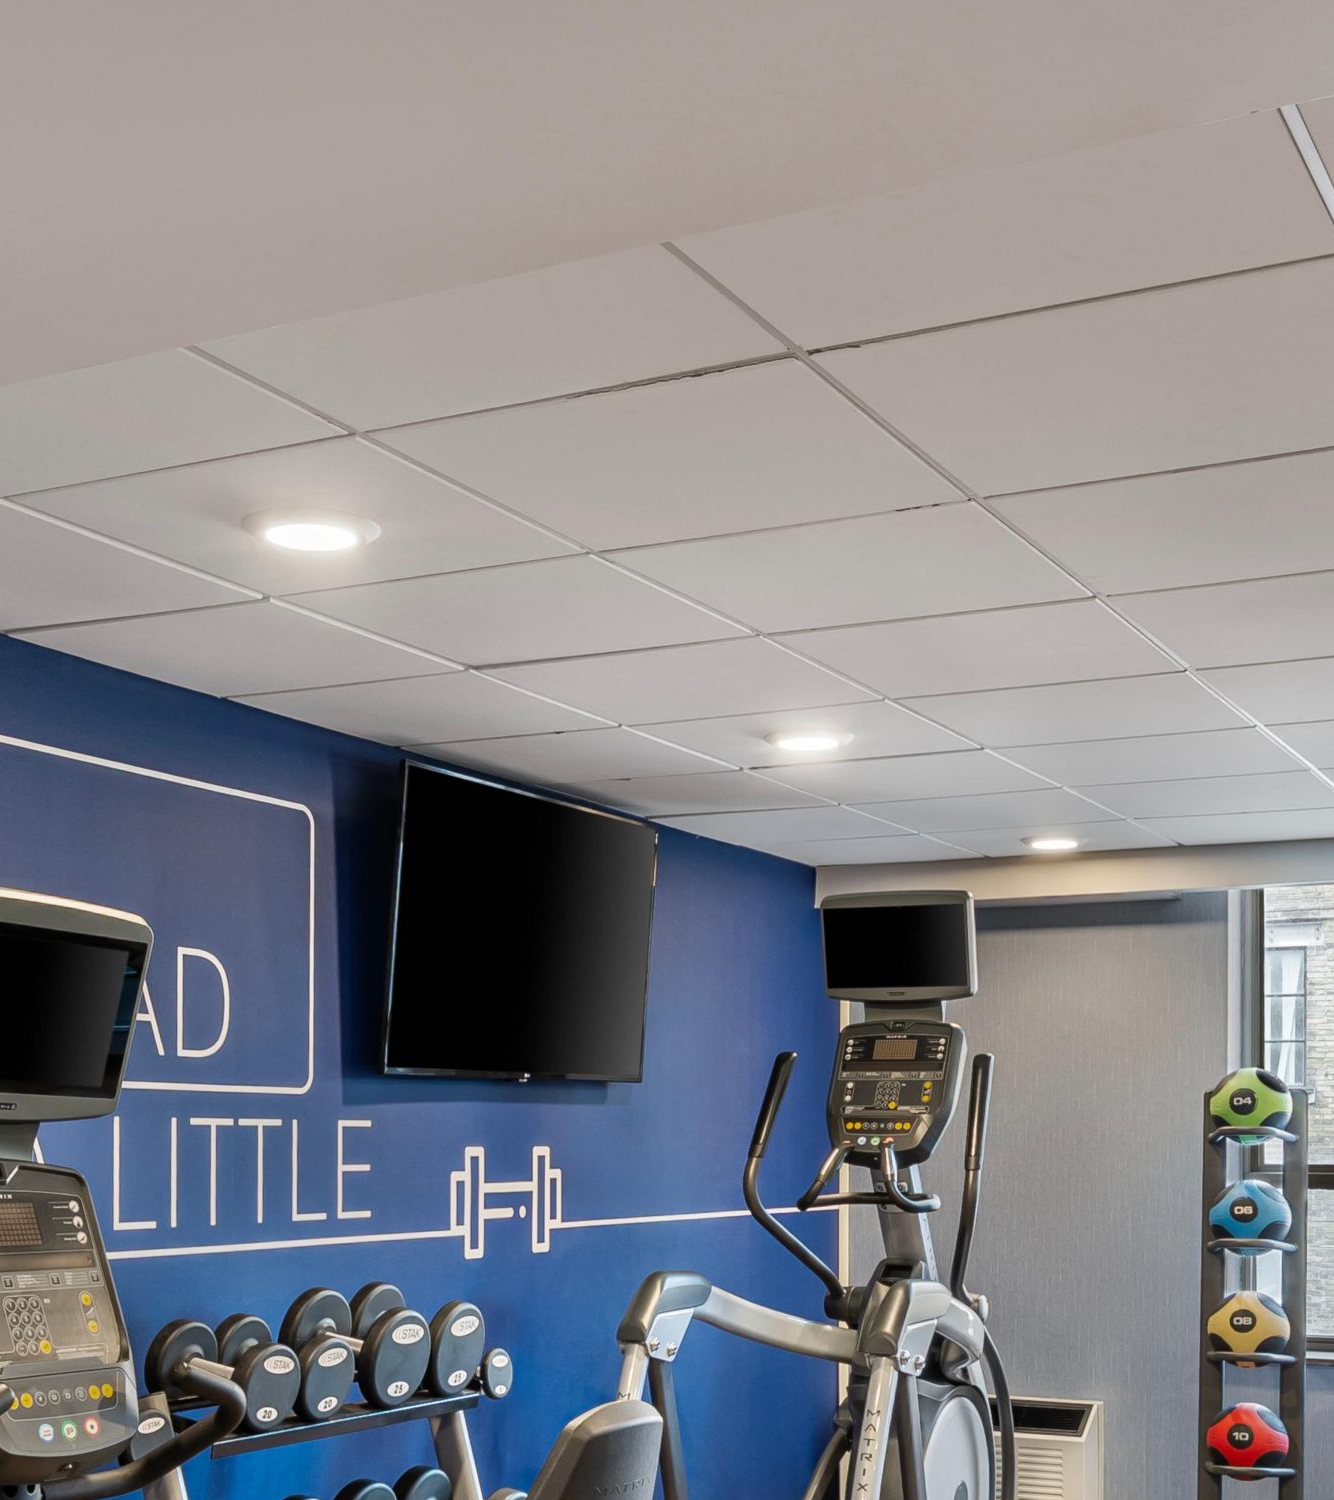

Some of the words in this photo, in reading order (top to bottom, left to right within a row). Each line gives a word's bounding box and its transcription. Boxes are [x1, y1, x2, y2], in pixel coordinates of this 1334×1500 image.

[1233, 1097, 1252, 1105] 04
[113, 1116, 372, 1230] LITTLE
[394, 1385, 403, 1394] 25
[323, 1399, 332, 1409] 20
[262, 1410, 272, 1419] 20
[1232, 1432, 1249, 1440] 10
[857, 1409, 881, 1492] MATRIX
